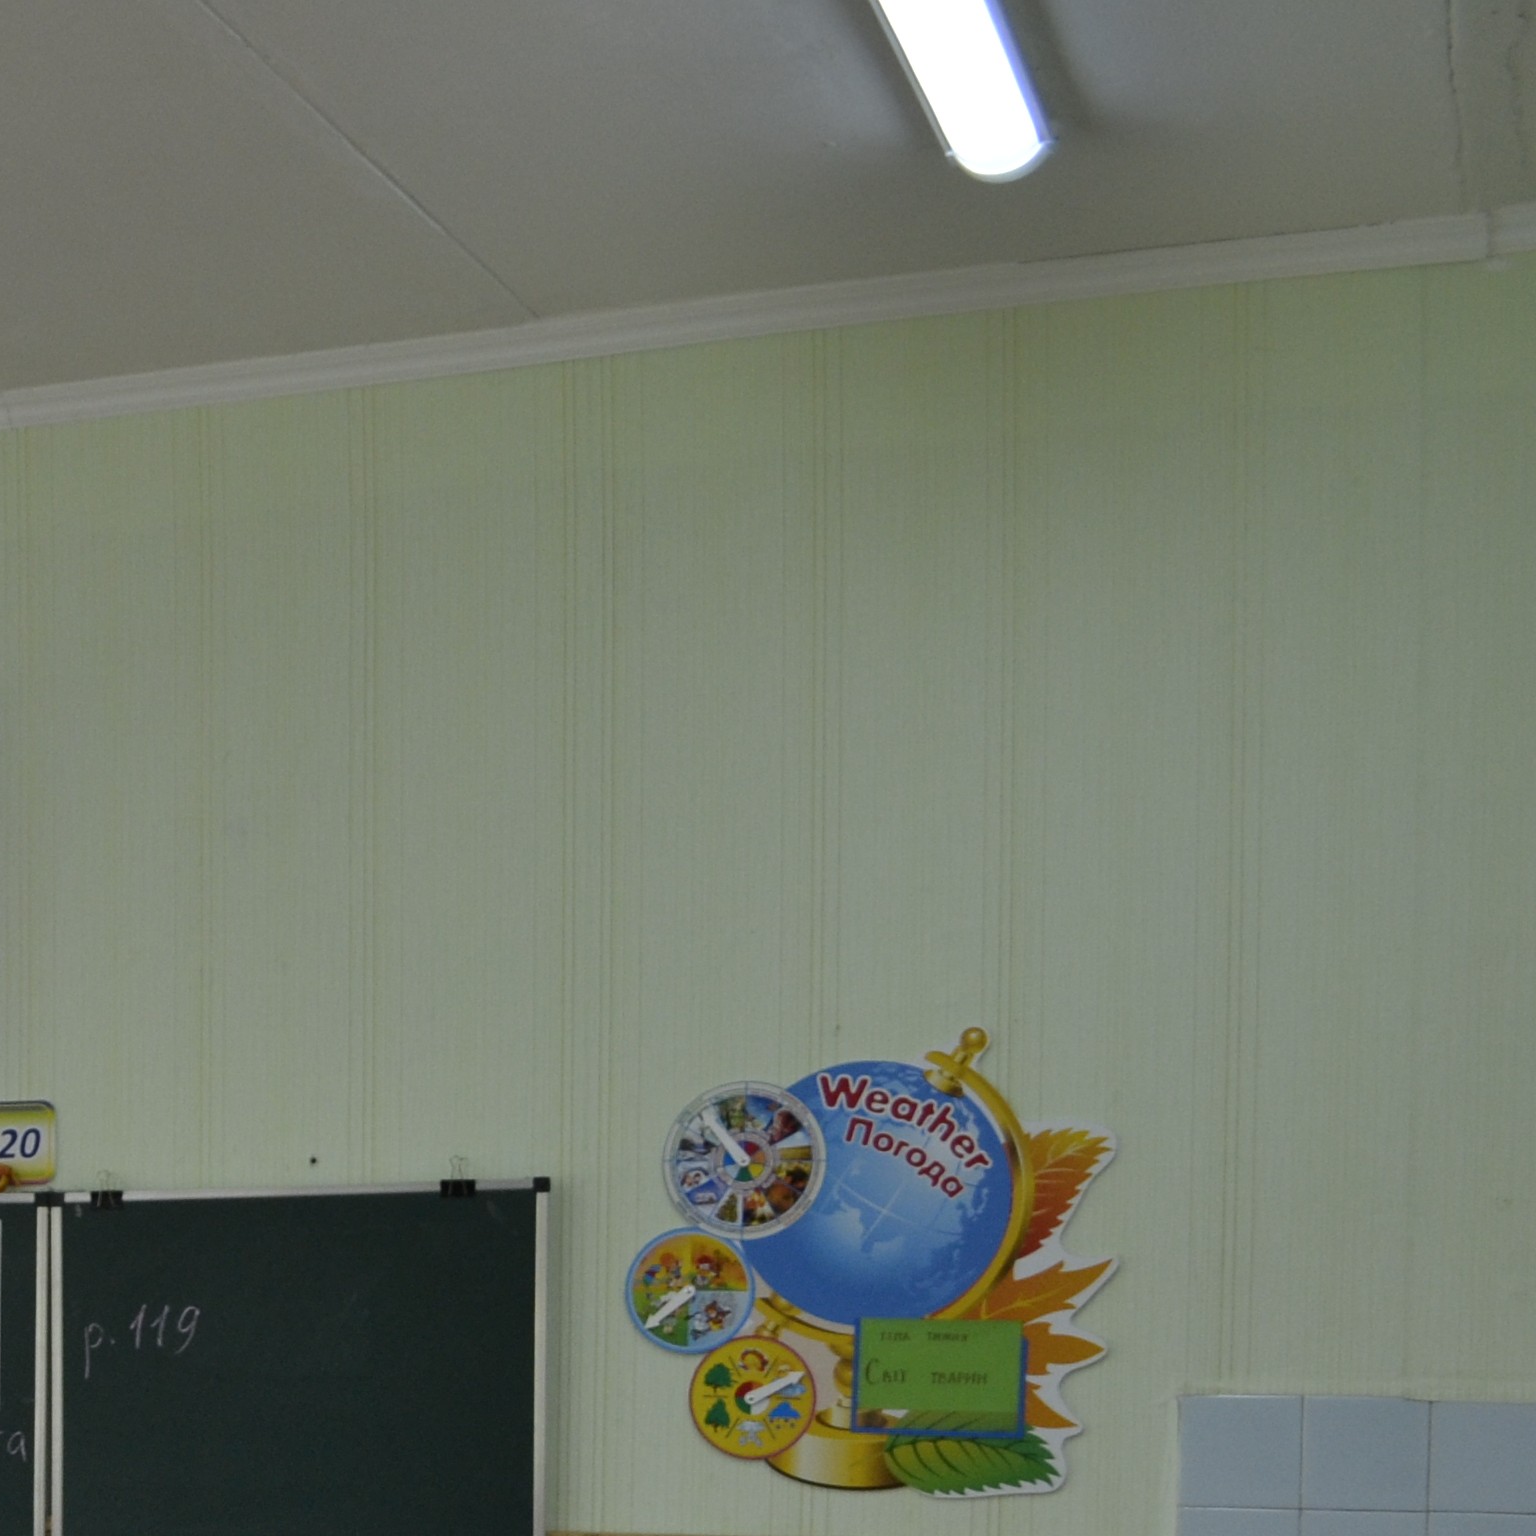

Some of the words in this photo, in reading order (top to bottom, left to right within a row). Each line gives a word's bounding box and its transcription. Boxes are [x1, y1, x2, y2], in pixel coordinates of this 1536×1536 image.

[817, 1073, 993, 1172] Weather
[844, 1117, 965, 1201] Погода
[130, 1304, 200, 1354] 119
